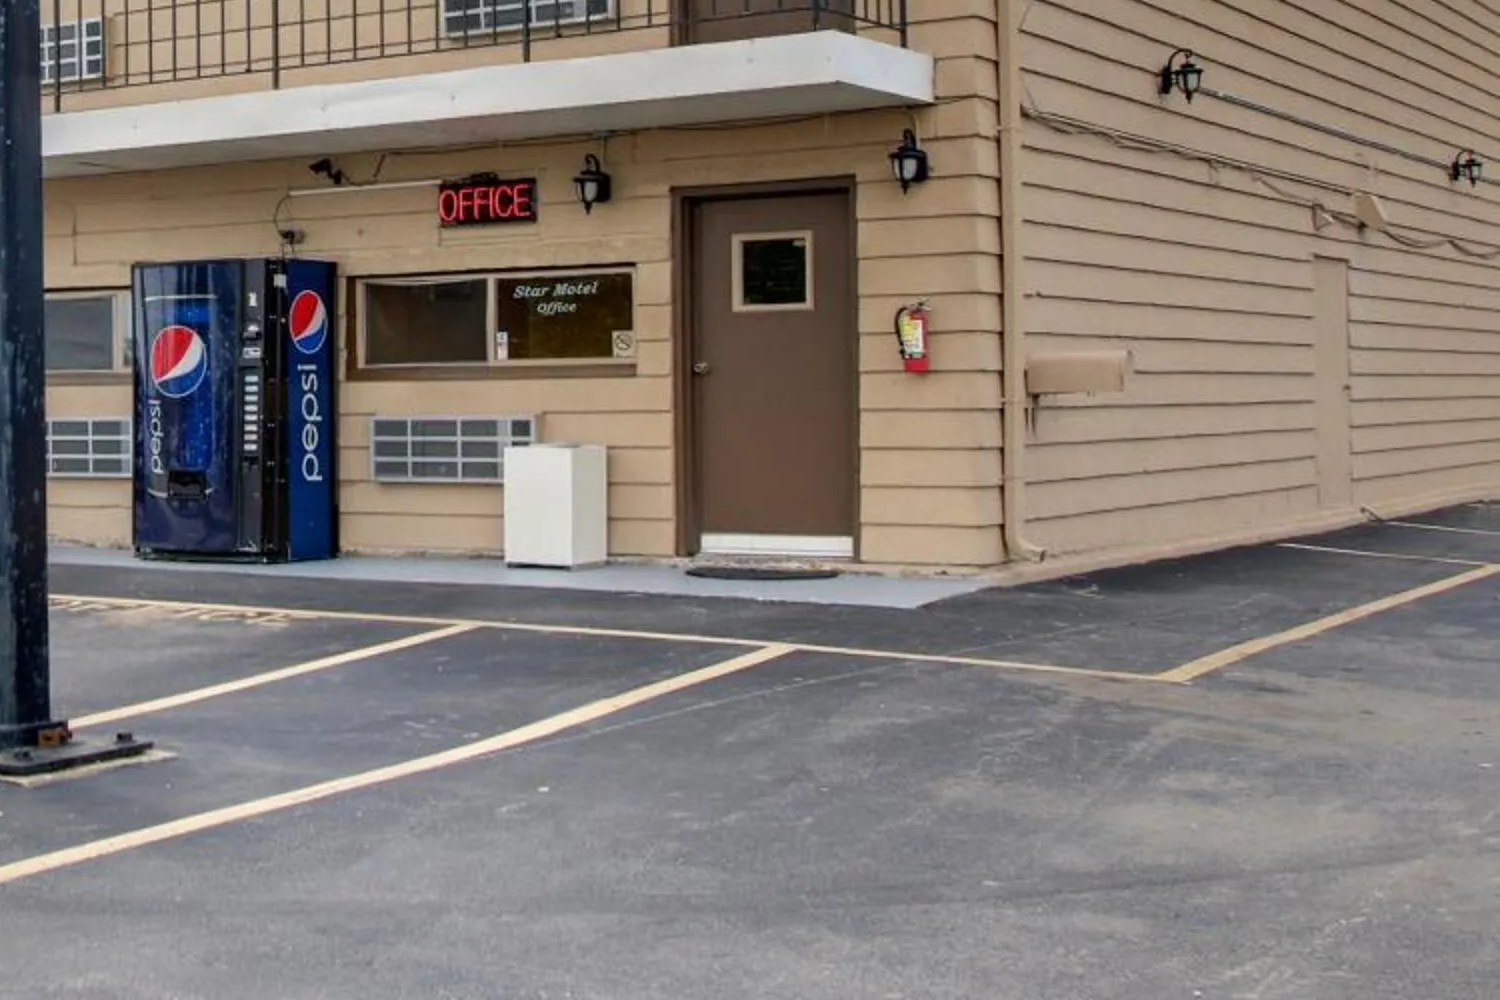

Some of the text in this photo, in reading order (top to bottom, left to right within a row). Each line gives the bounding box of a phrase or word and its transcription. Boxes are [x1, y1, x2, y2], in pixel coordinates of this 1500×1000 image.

[438, 184, 531, 223] OFFICE
[513, 280, 598, 299] Star Motel
[149, 399, 164, 474] pepsi
[298, 363, 323, 482] pepsi
